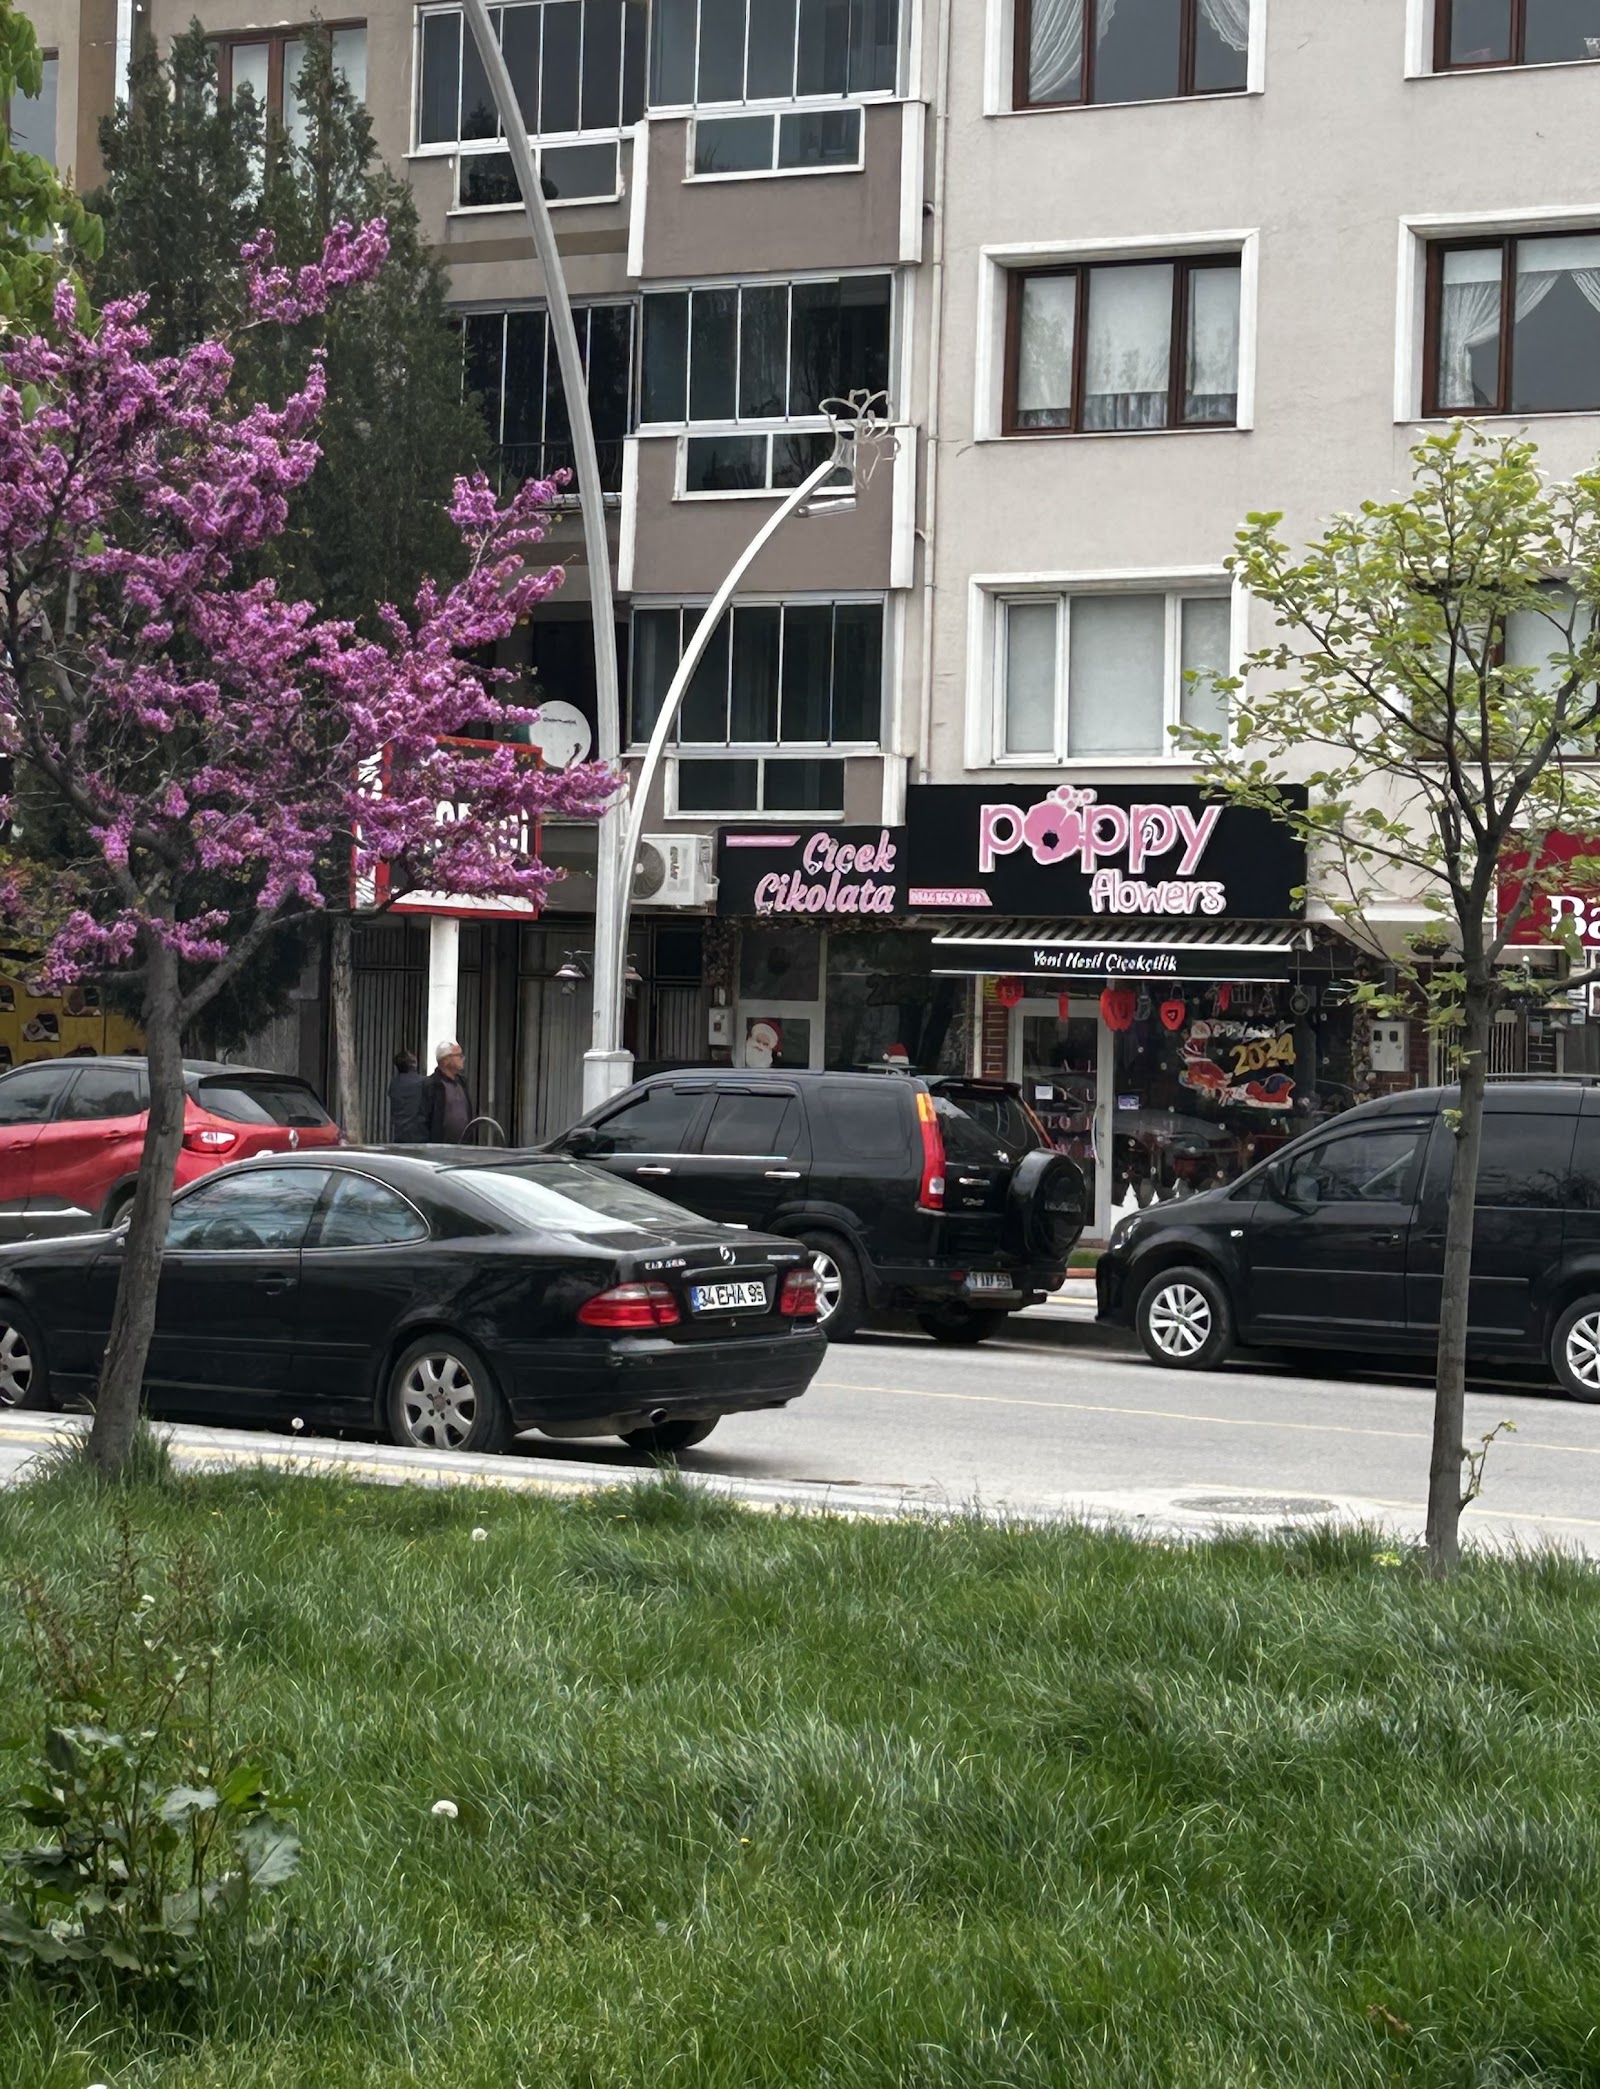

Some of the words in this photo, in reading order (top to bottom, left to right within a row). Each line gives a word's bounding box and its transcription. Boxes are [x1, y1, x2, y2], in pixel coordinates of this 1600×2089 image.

[1089, 868, 1227, 915] flowers
[1066, 951, 1104, 969] Nesil
[1229, 1033, 1296, 1077] 2024
